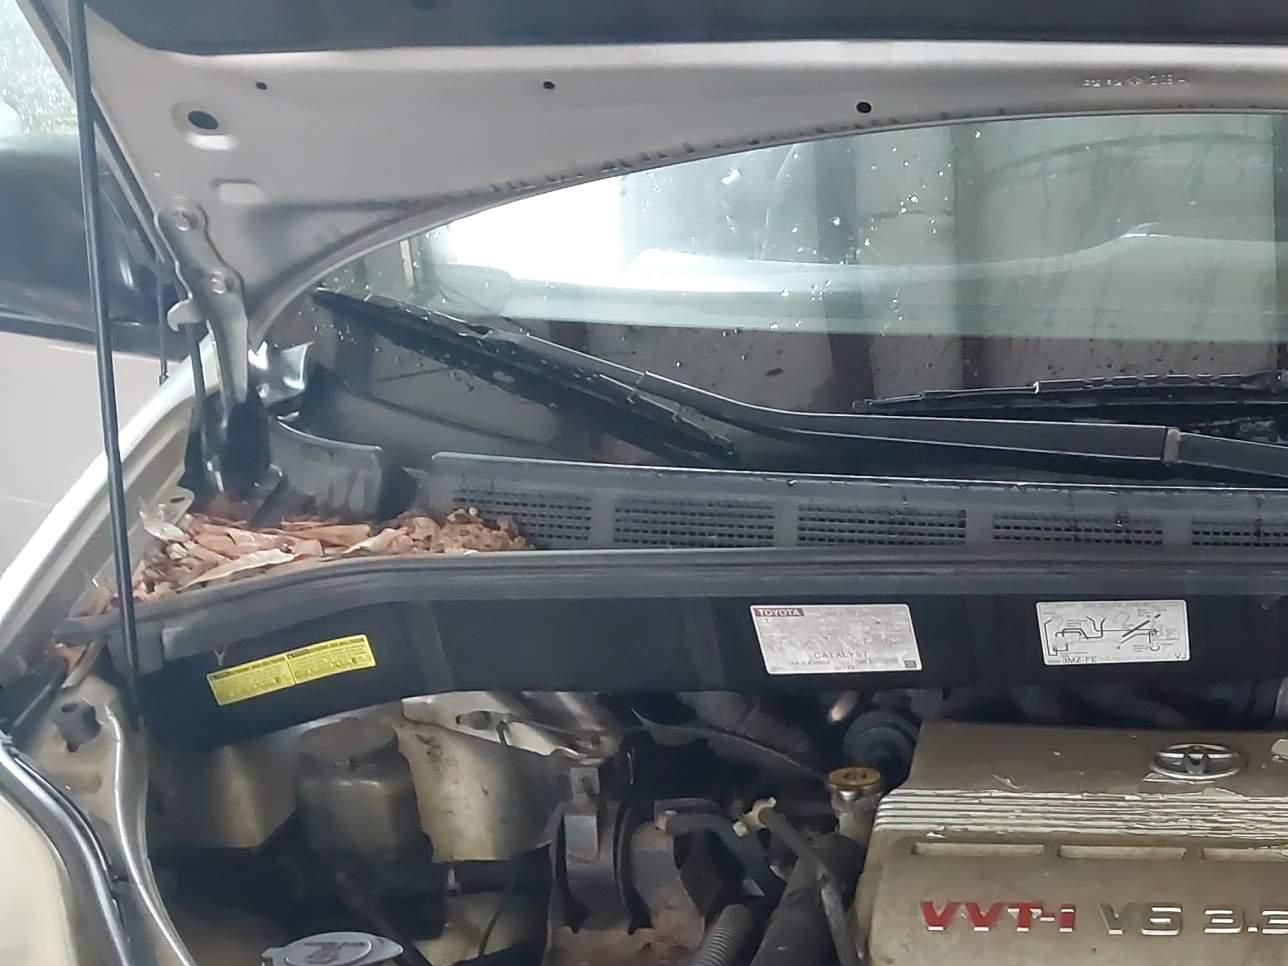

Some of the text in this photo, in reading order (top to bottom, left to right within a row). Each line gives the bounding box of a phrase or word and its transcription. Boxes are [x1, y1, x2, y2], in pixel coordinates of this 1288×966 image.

[758, 608, 801, 616] TOYOTA
[814, 651, 870, 659] CATALYST
[1098, 902, 1183, 936] V6
